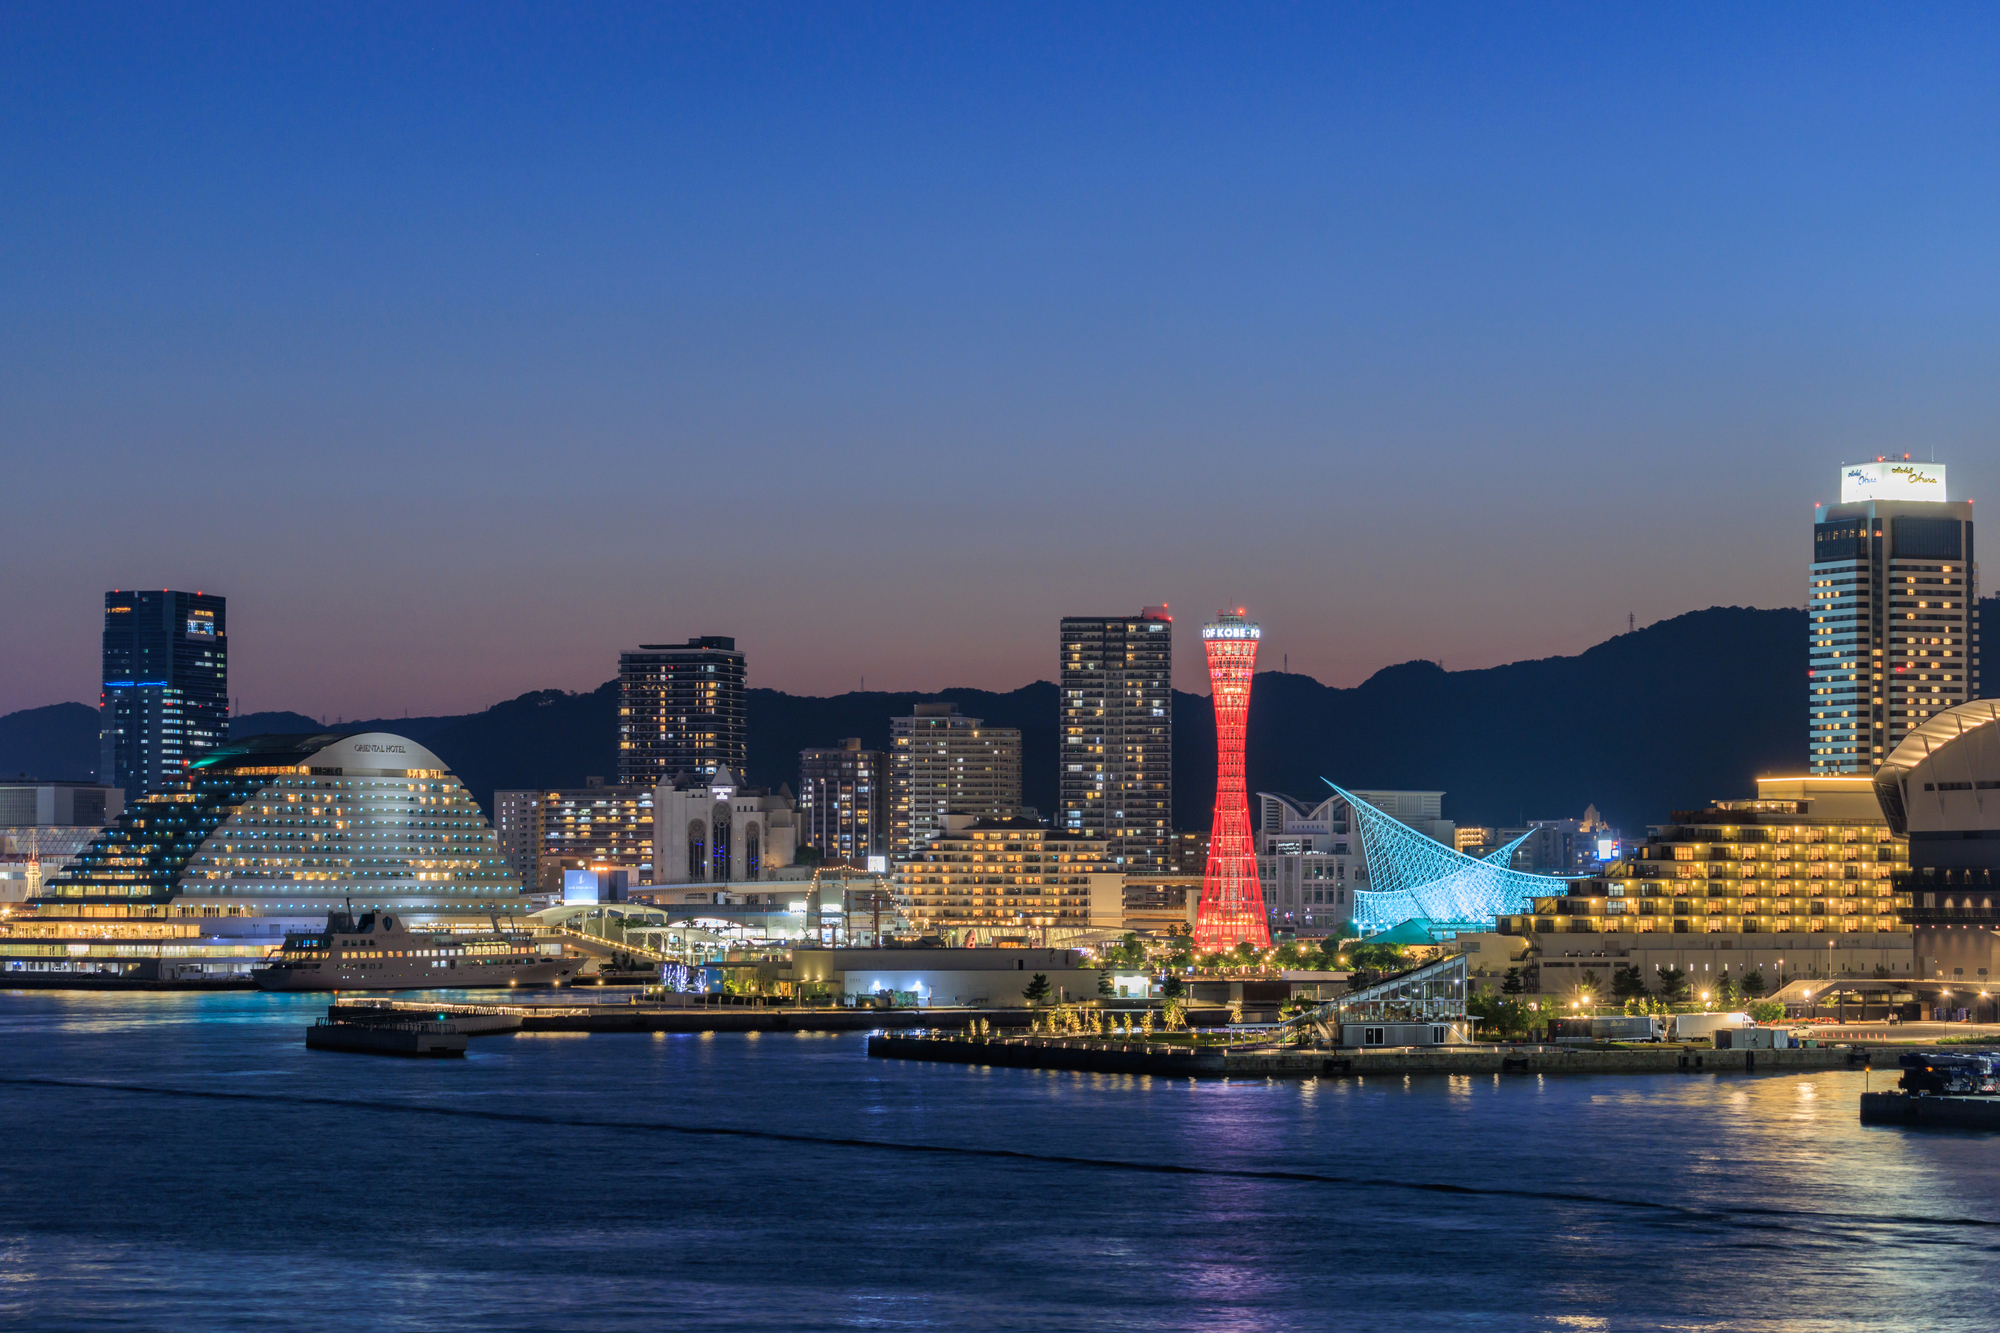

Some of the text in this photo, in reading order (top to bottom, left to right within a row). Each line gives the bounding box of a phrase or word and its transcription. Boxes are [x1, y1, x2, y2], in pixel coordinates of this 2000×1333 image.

[1205, 628, 1216, 638] OF
[1217, 628, 1246, 638] KOBE
[354, 744, 406, 754] ORIENTAL HOTEL
